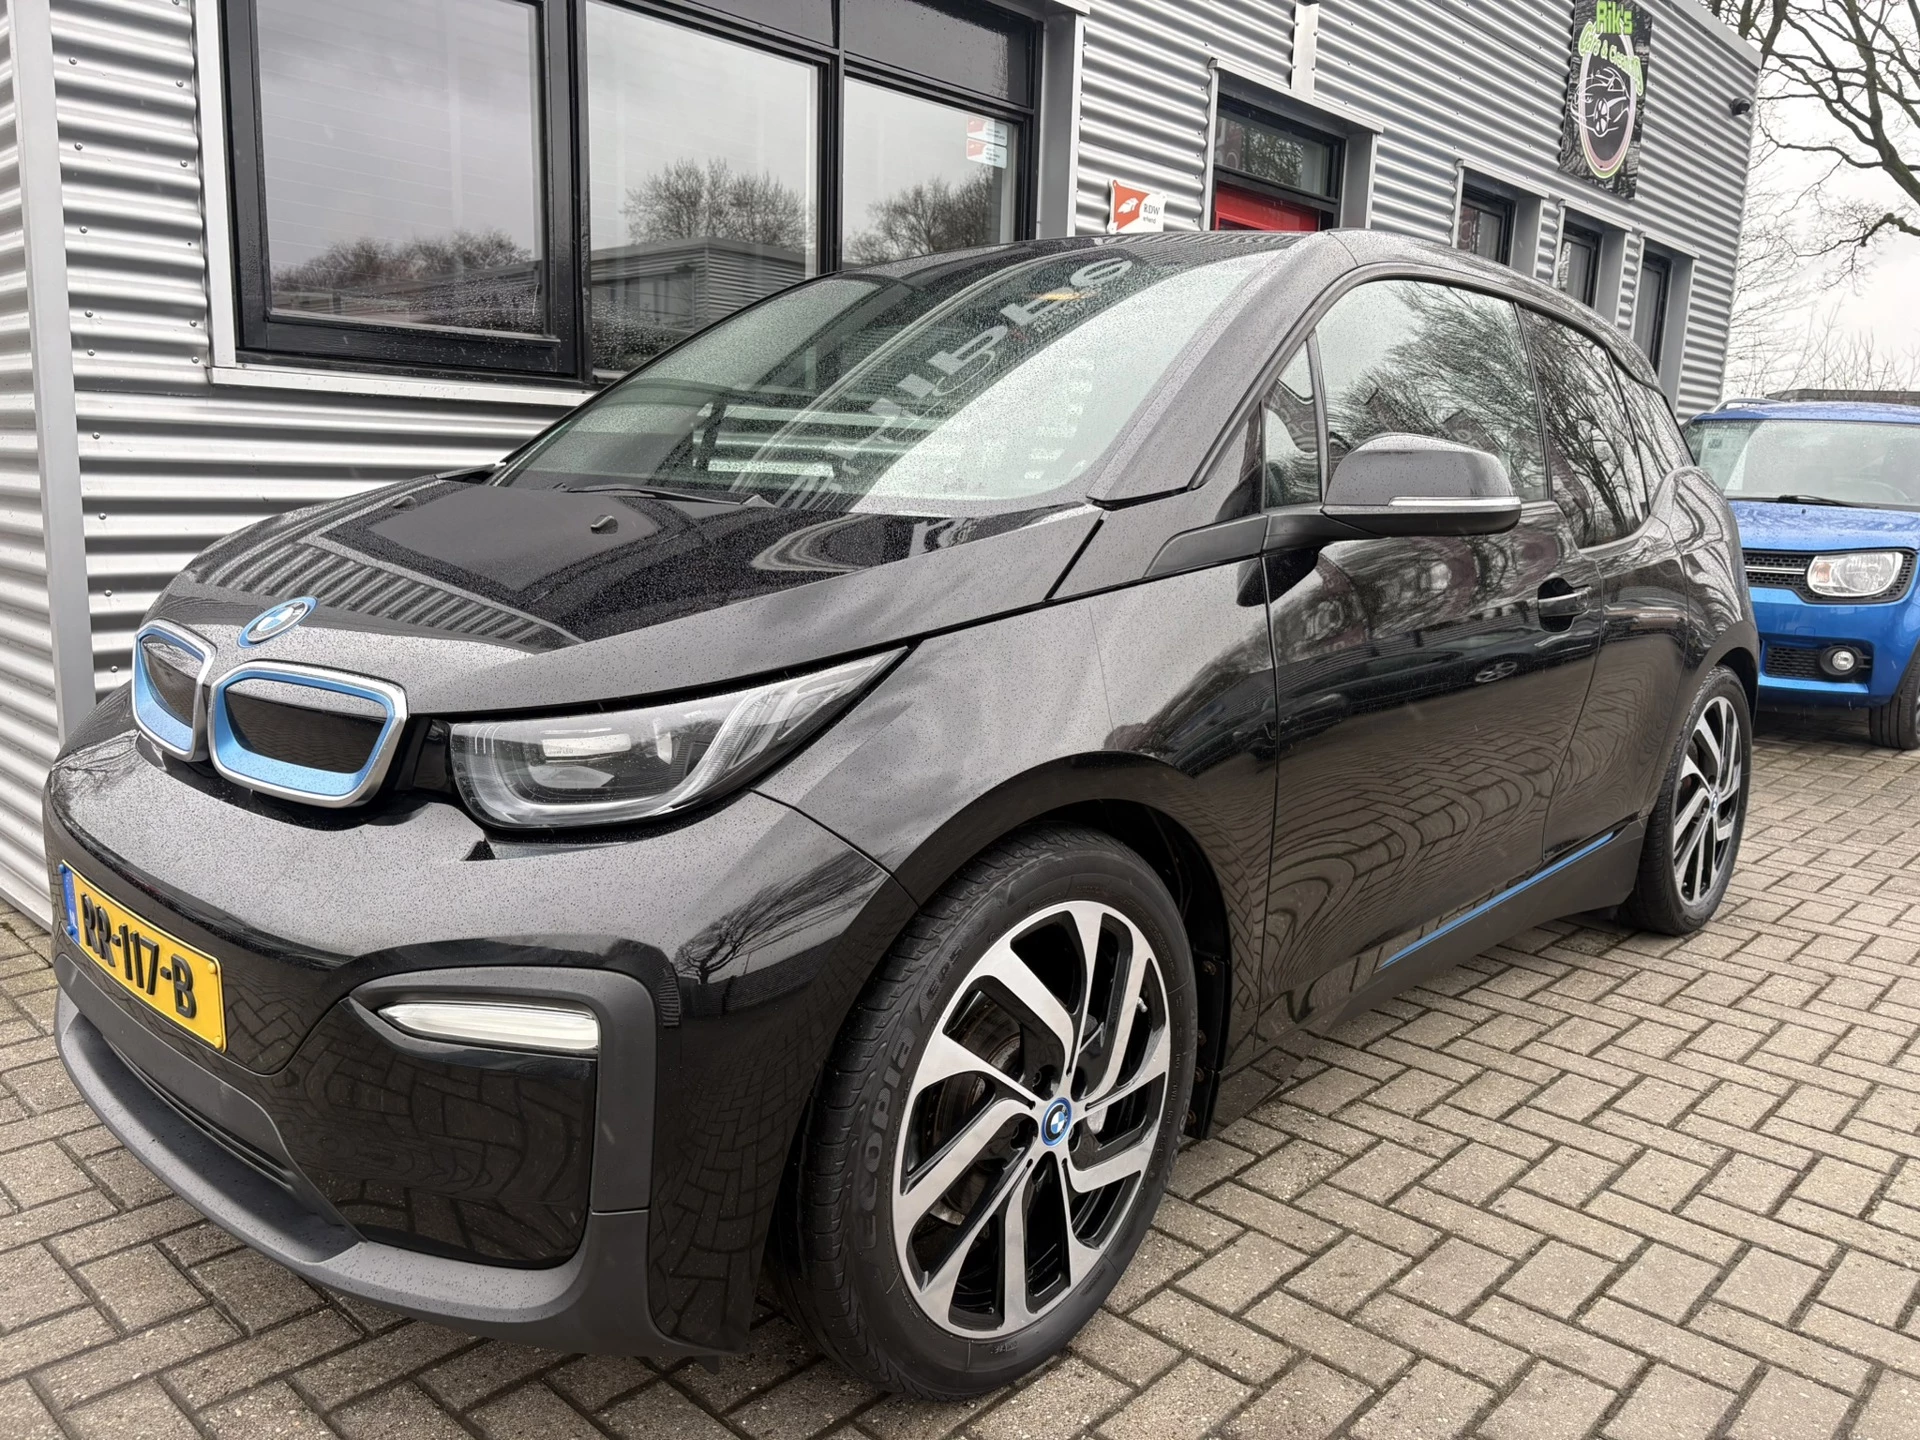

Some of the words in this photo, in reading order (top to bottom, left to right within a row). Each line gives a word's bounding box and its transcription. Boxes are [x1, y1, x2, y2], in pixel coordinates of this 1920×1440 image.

[1596, 0, 1633, 35] Rik's
[1143, 202, 1161, 215] RDW
[80, 891, 197, 1020] RR-117-B
[857, 1026, 917, 1250] ECOPIA
